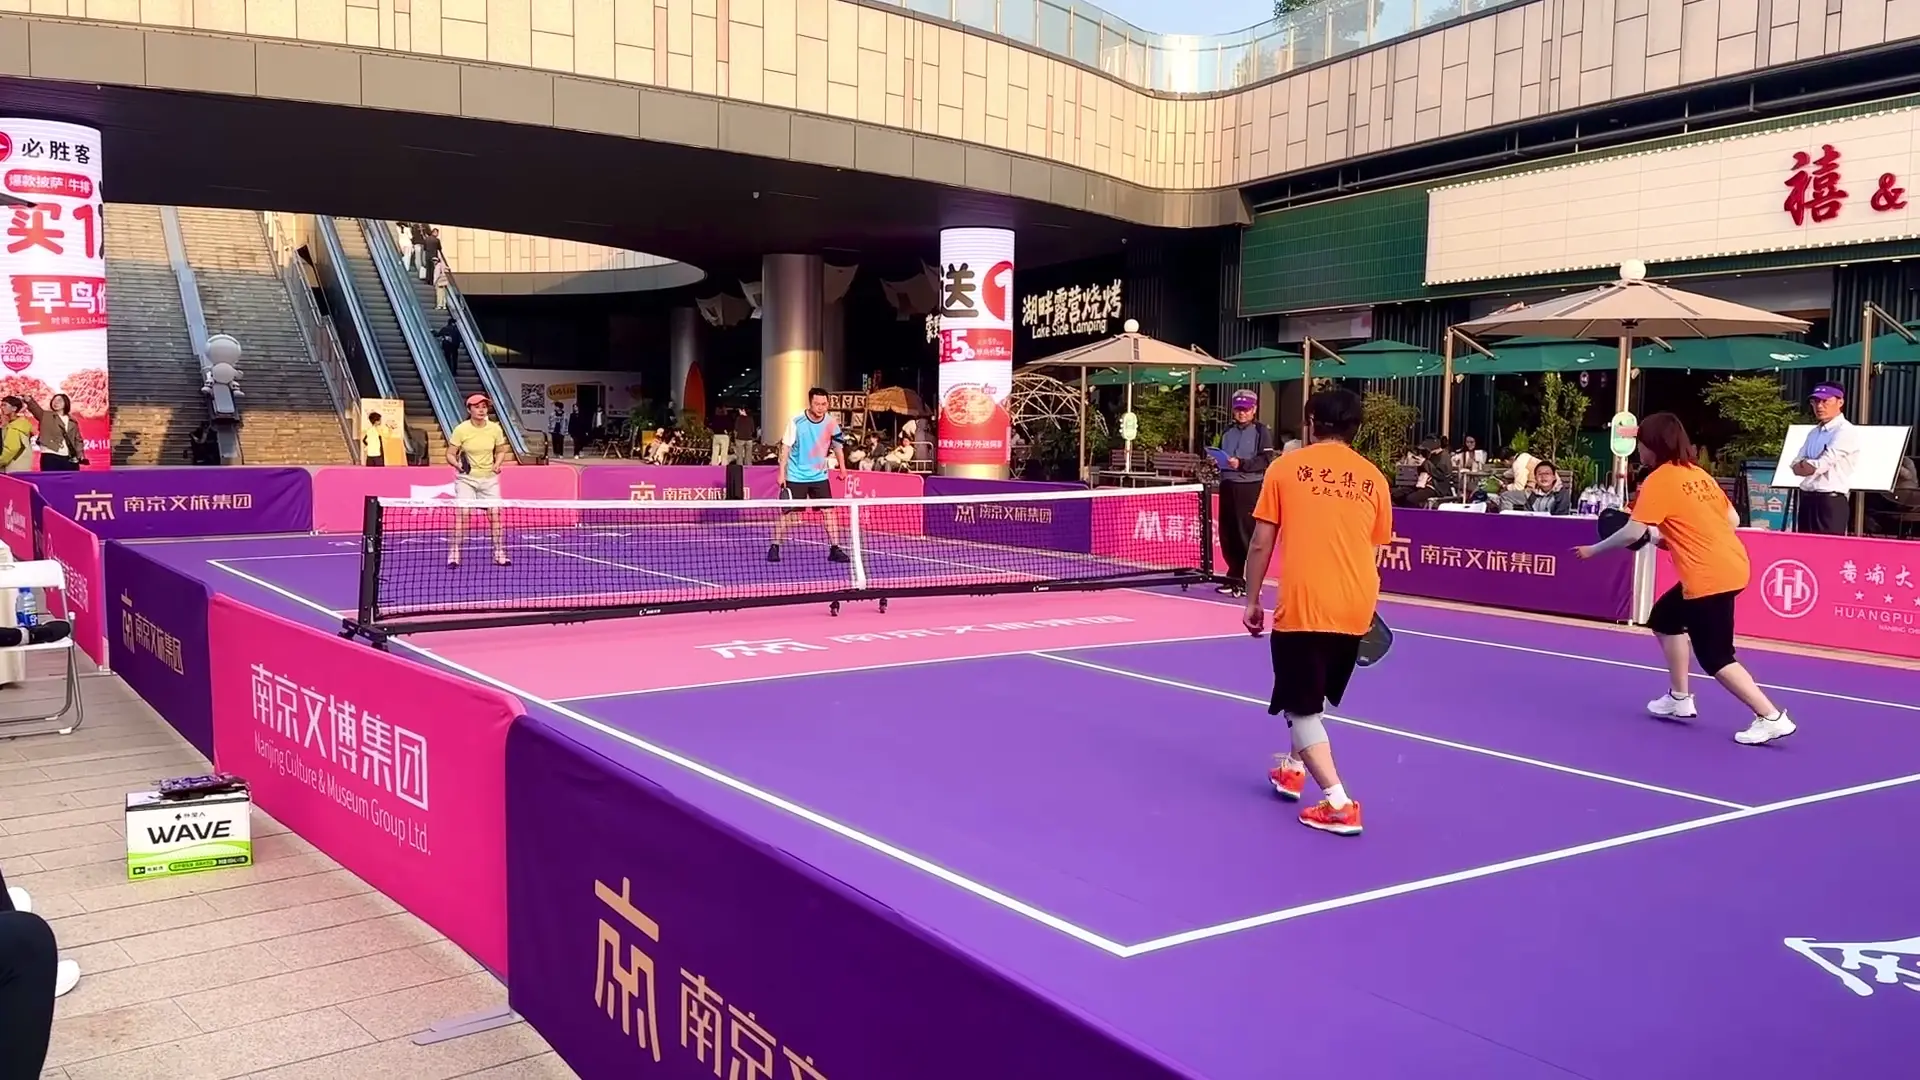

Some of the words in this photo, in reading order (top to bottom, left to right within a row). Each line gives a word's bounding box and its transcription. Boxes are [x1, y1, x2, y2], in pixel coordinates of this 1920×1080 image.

[21, 137, 91, 165] 必胜客
[1784, 144, 1849, 226] 禧
[1871, 172, 1908, 212] &
[1022, 278, 1122, 327] 湖畔露营烧烤
[1032, 323, 1051, 339] Lake
[1052, 321, 1070, 337] Side
[1070, 319, 1108, 335] Camping
[1297, 465, 1374, 496] 演艺集团
[124, 493, 252, 512] 南京文旅集团
[979, 503, 1052, 524] 南京文旅集团
[1420, 544, 1556, 577] 南京文旅集团
[1839, 559, 1914, 589] 黄埔大
[1834, 605, 1914, 625] HUANGPU
[134, 612, 184, 676] 南京文旅集团
[250, 663, 429, 811] 南京文博集团
[254, 730, 285, 776] Nanjing
[285, 749, 317, 790] Culture
[318, 768, 326, 794] &
[327, 772, 369, 820] Museum
[371, 798, 406, 847] Group
[408, 817, 432, 856] Ltd.
[147, 819, 232, 845] WAVE
